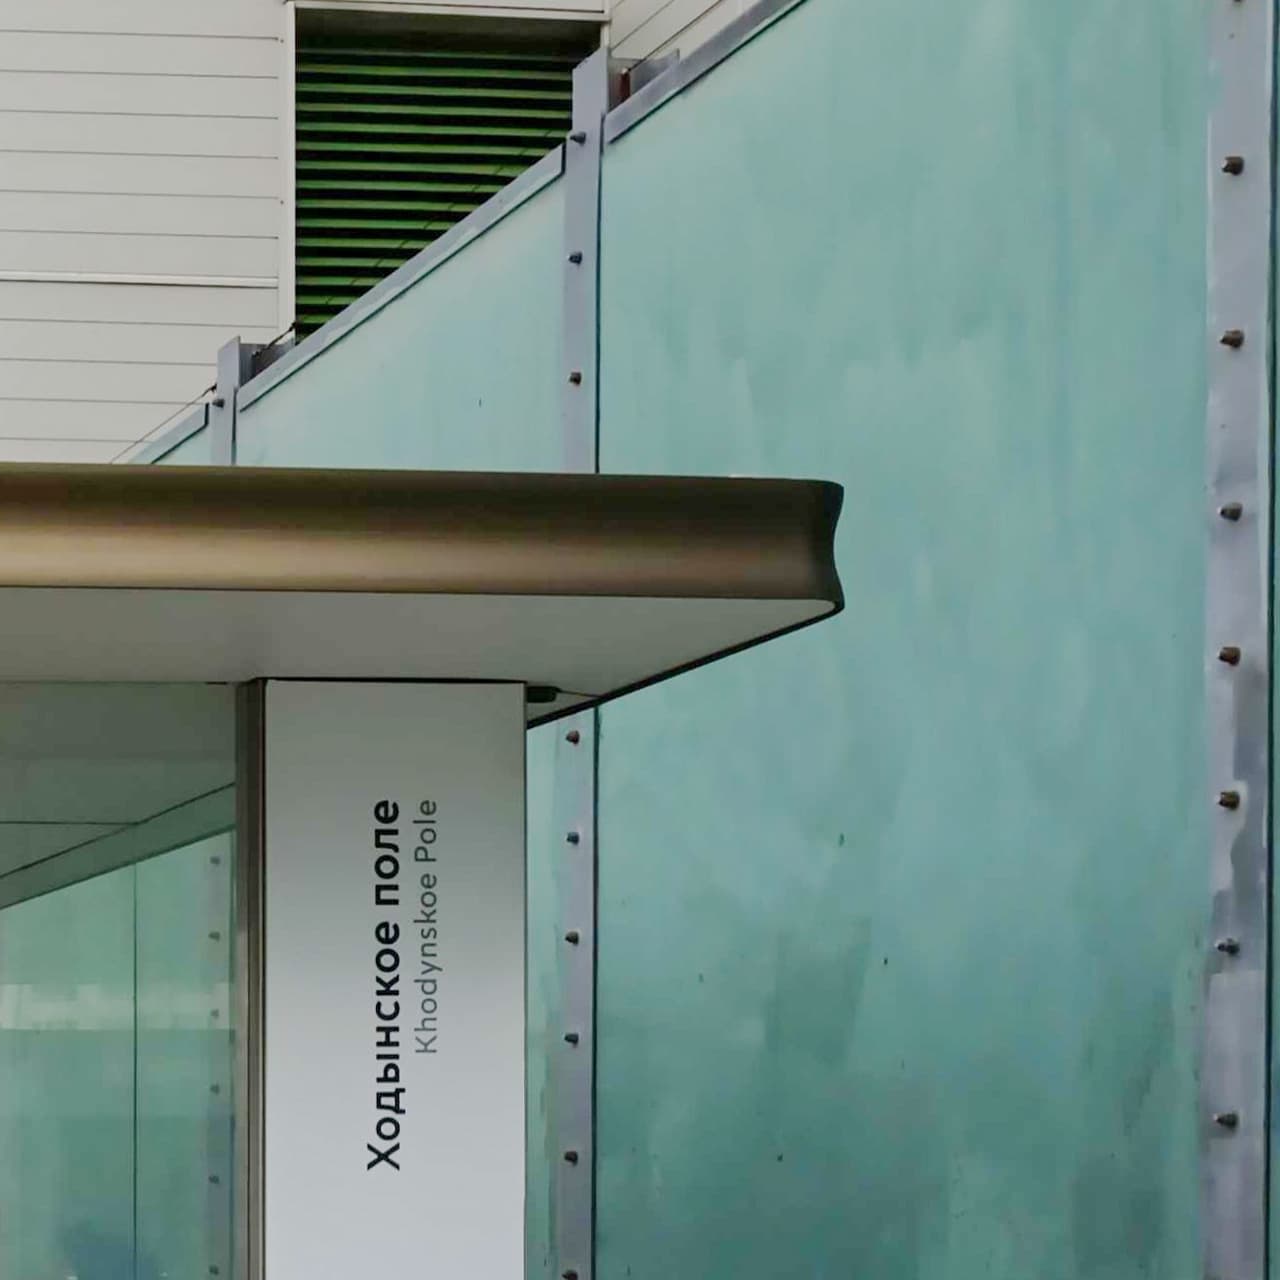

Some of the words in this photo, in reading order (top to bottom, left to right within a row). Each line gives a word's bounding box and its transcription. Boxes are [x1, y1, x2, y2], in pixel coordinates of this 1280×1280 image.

[374, 800, 400, 906] поле
[413, 800, 437, 863] Pole
[414, 873, 443, 1054] Khodynskoe
[367, 921, 406, 1170] Ходынское
